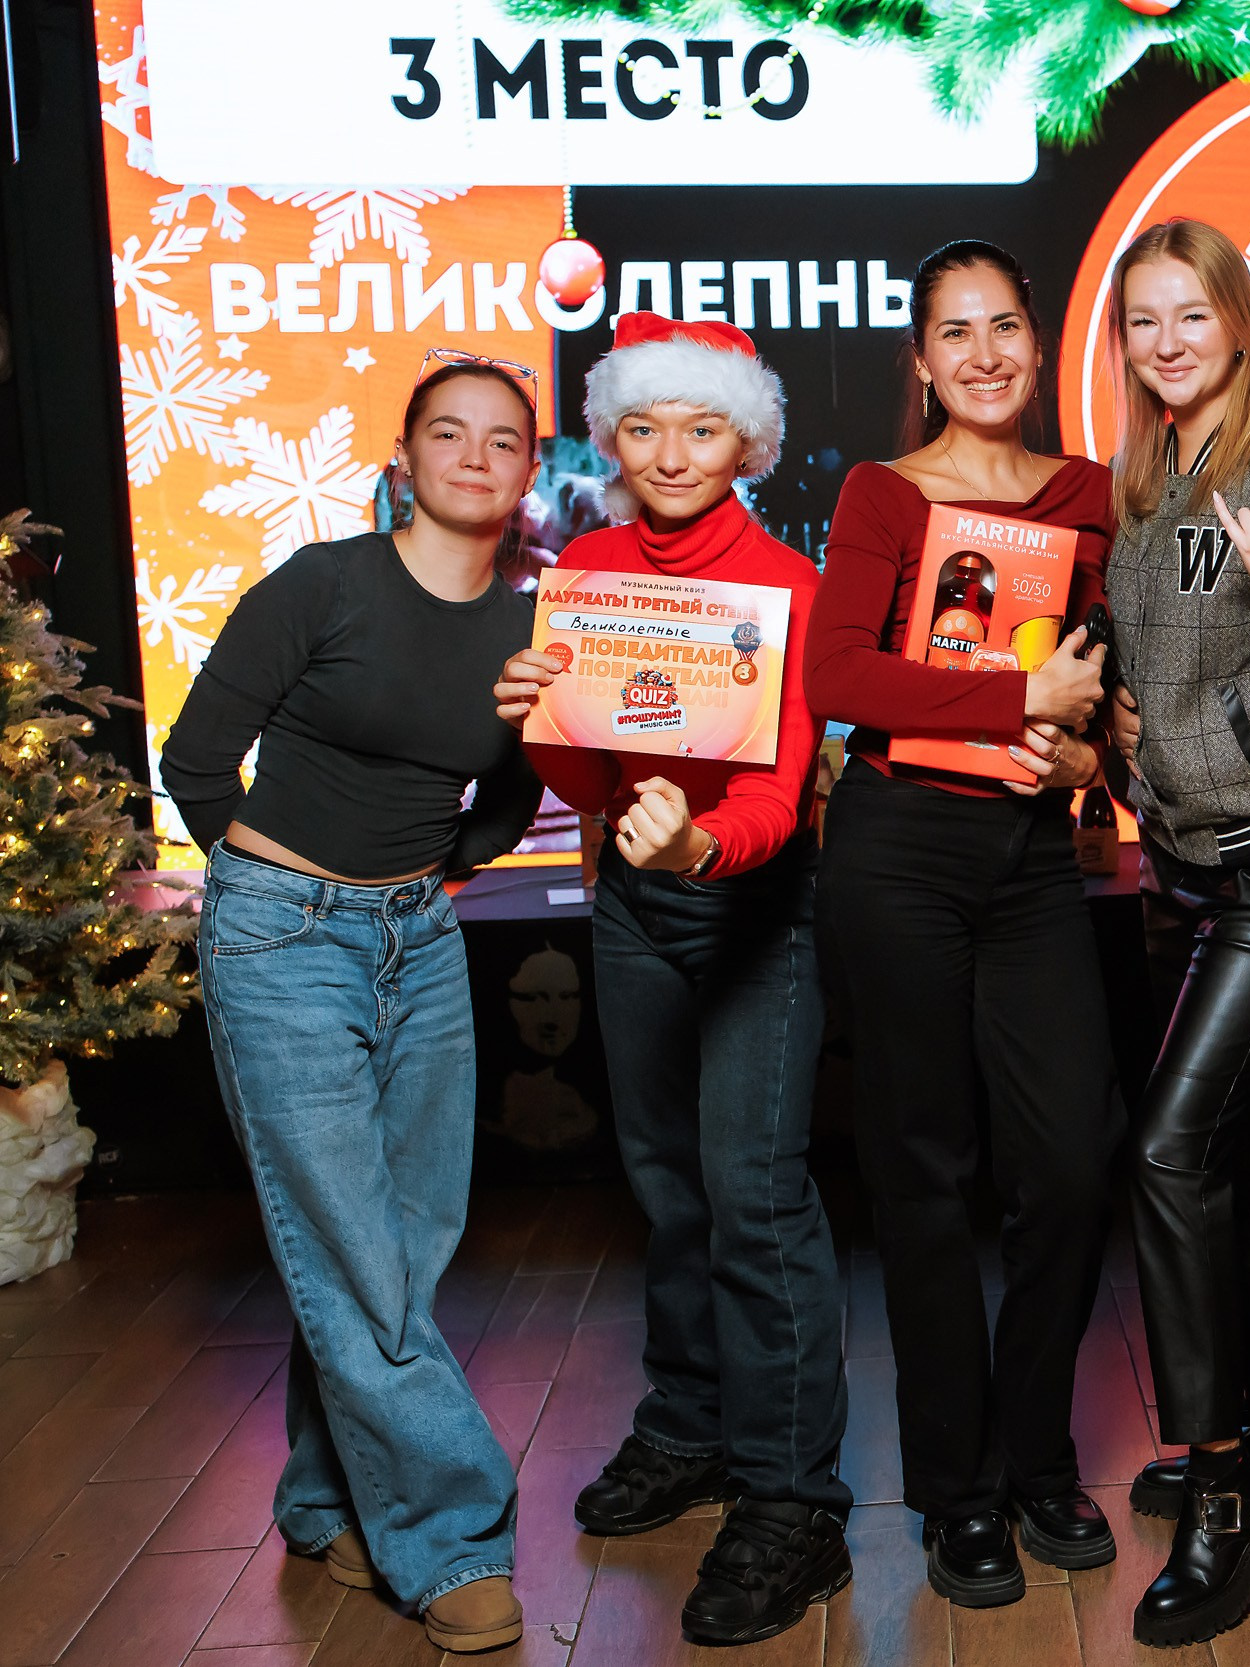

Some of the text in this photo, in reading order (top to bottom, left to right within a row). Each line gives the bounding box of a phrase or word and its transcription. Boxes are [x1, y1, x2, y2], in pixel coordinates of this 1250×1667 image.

[389, 37, 810, 121] 3 МЕСТО
[956, 516, 1048, 549] MARTINI
[940, 532, 1060, 560] ВКУС ИТАЛЬЯНСКОЙ ЖИЗНИ
[1175, 525, 1235, 595] W
[620, 580, 706, 594] МУЗЫКАЛЬНЫЙ КВИЗ
[1011, 578, 1051, 598] 50/50
[541, 589, 760, 620] ЛАУРЕАТЫ ТРЕТЬЕЙ СТЕПЕ
[570, 616, 691, 639] Великолепные
[580, 636, 733, 667] ПОБЕДИТЕЛИ!
[931, 635, 979, 652] MARTIN
[739, 665, 750, 680] 3
[629, 687, 669, 705] QUIZ
[617, 708, 682, 725] #ПОШУМИМ?
[639, 719, 682, 729] #MUSIC GAME
